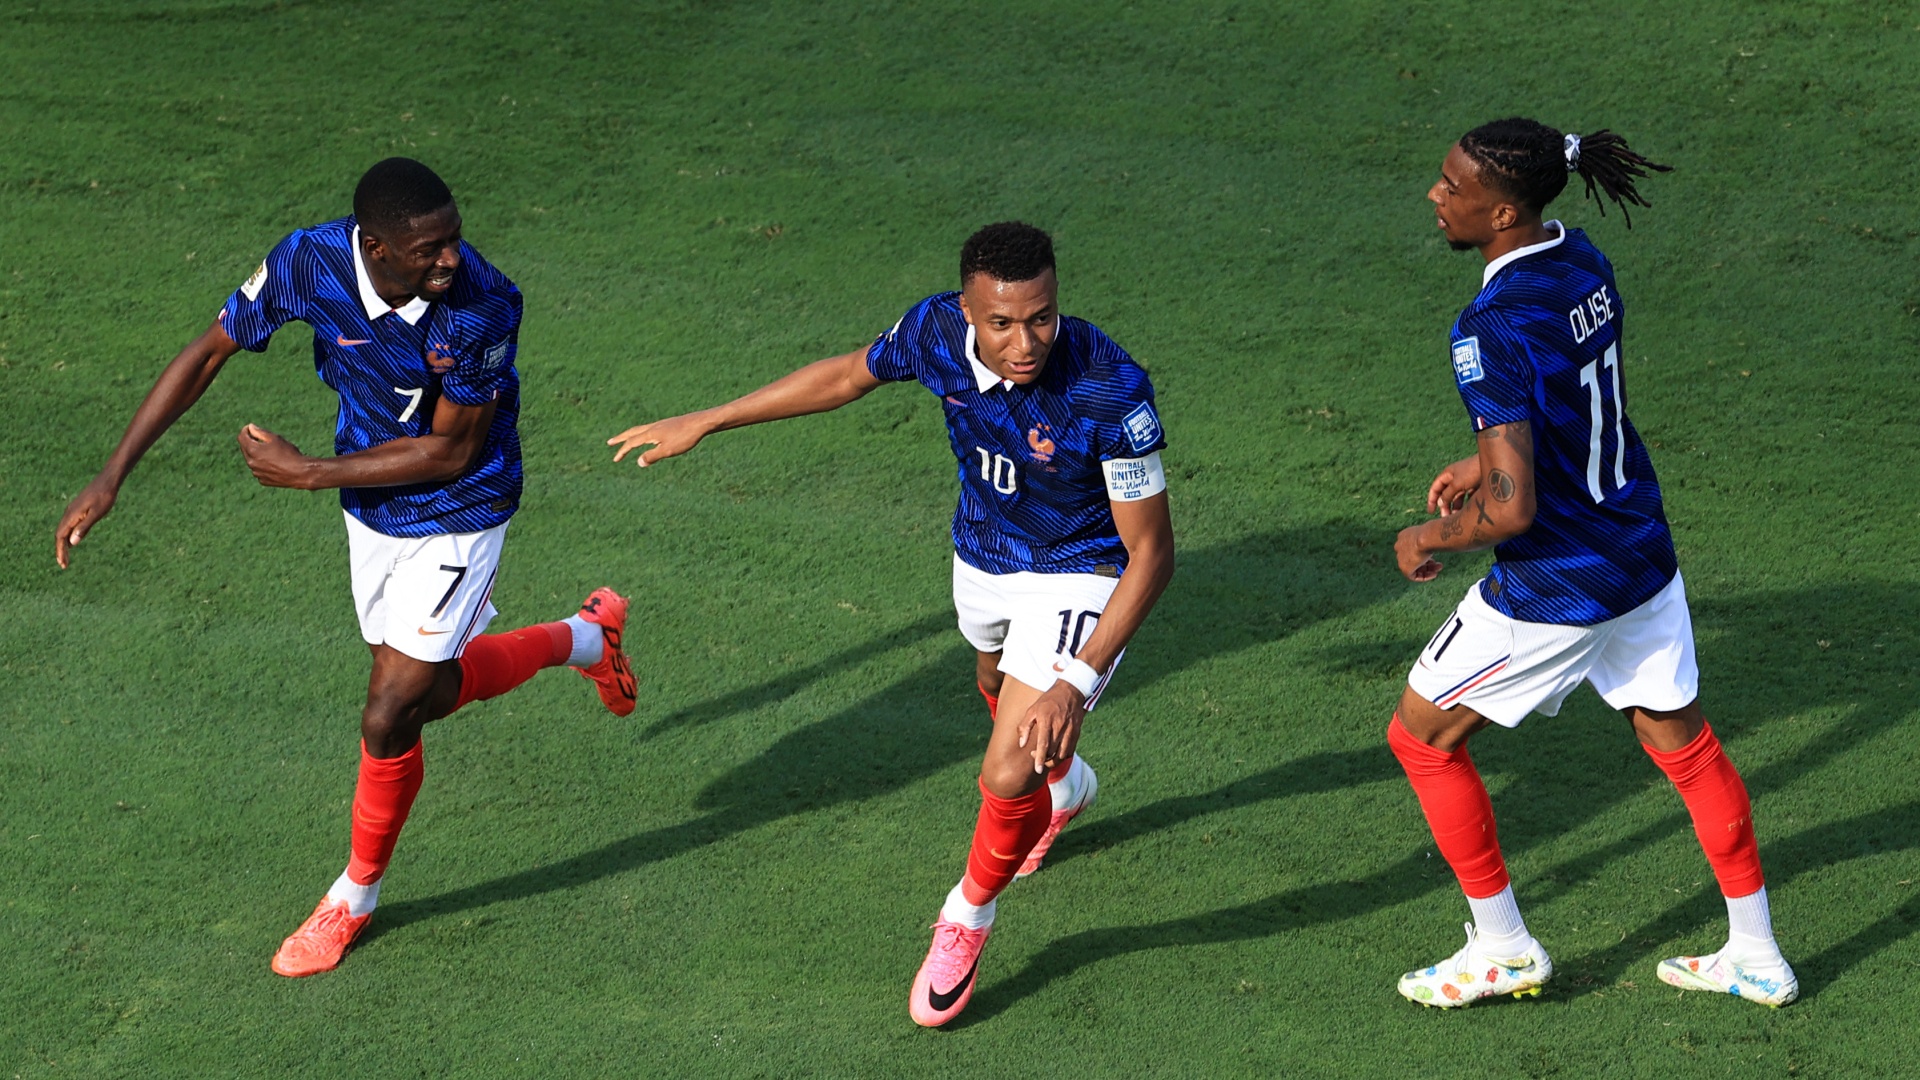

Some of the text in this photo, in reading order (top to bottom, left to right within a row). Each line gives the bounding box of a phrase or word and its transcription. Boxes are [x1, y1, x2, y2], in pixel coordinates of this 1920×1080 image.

[1569, 284, 1615, 345] OLISE
[394, 386, 423, 423] 7
[1131, 415, 1153, 434] UNITES
[1580, 341, 1628, 505] 11
[976, 446, 1017, 495] 10
[1111, 460, 1146, 470] FOOTBALL
[1111, 468, 1147, 481] UNITES
[1111, 476, 1150, 490] the World
[1124, 490, 1141, 498] FIFA
[429, 564, 467, 619] 7
